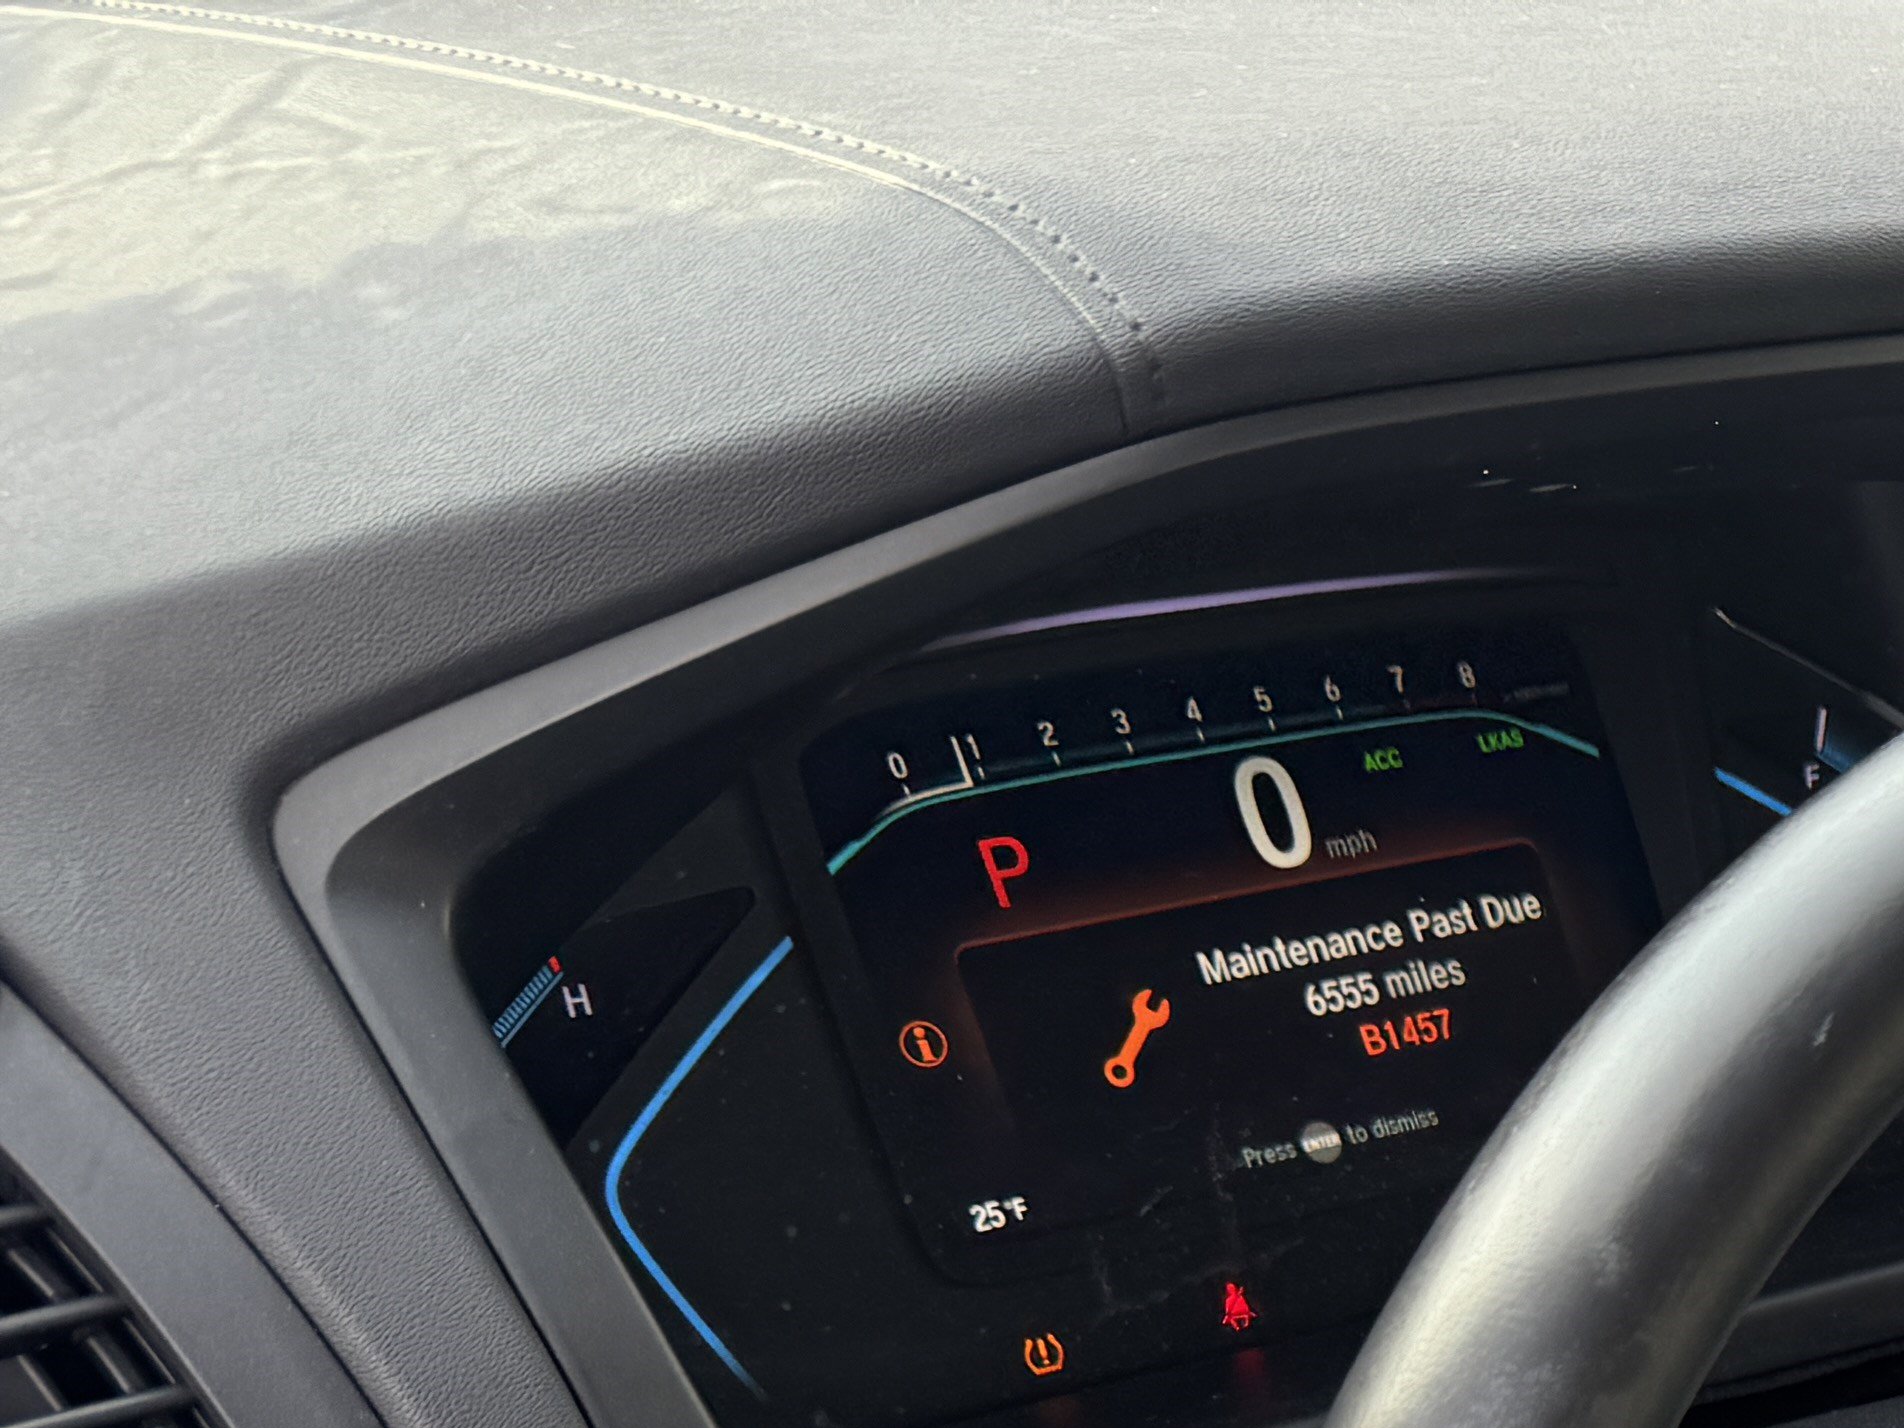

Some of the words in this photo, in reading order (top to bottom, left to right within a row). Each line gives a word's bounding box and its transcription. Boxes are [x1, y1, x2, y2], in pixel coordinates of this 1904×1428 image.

[886, 751, 909, 780] 0
[964, 733, 981, 760] 1
[1036, 721, 1059, 747] 2
[1110, 708, 1132, 735] 3
[1186, 695, 1203, 722] 4
[1253, 685, 1274, 713] 5
[1323, 675, 1343, 702] 6
[1386, 665, 1404, 694] 7
[1457, 660, 1477, 689] 8
[1475, 728, 1524, 753] LKAS
[1363, 747, 1403, 773] ACC
[1233, 755, 1312, 869] 0
[977, 836, 1030, 908] P
[1324, 828, 1378, 859] mph
[1195, 920, 1404, 985] Maintenance
[1406, 900, 1479, 943] Past
[1479, 892, 1543, 930] Due
[561, 983, 594, 1019] H
[1304, 971, 1380, 1017] 6555
[1383, 956, 1467, 1000] miles
[1359, 1007, 1451, 1057] B1457
[1241, 1142, 1298, 1168] Press
[1345, 1123, 1369, 1145] to
[1371, 1107, 1440, 1140] dismiss
